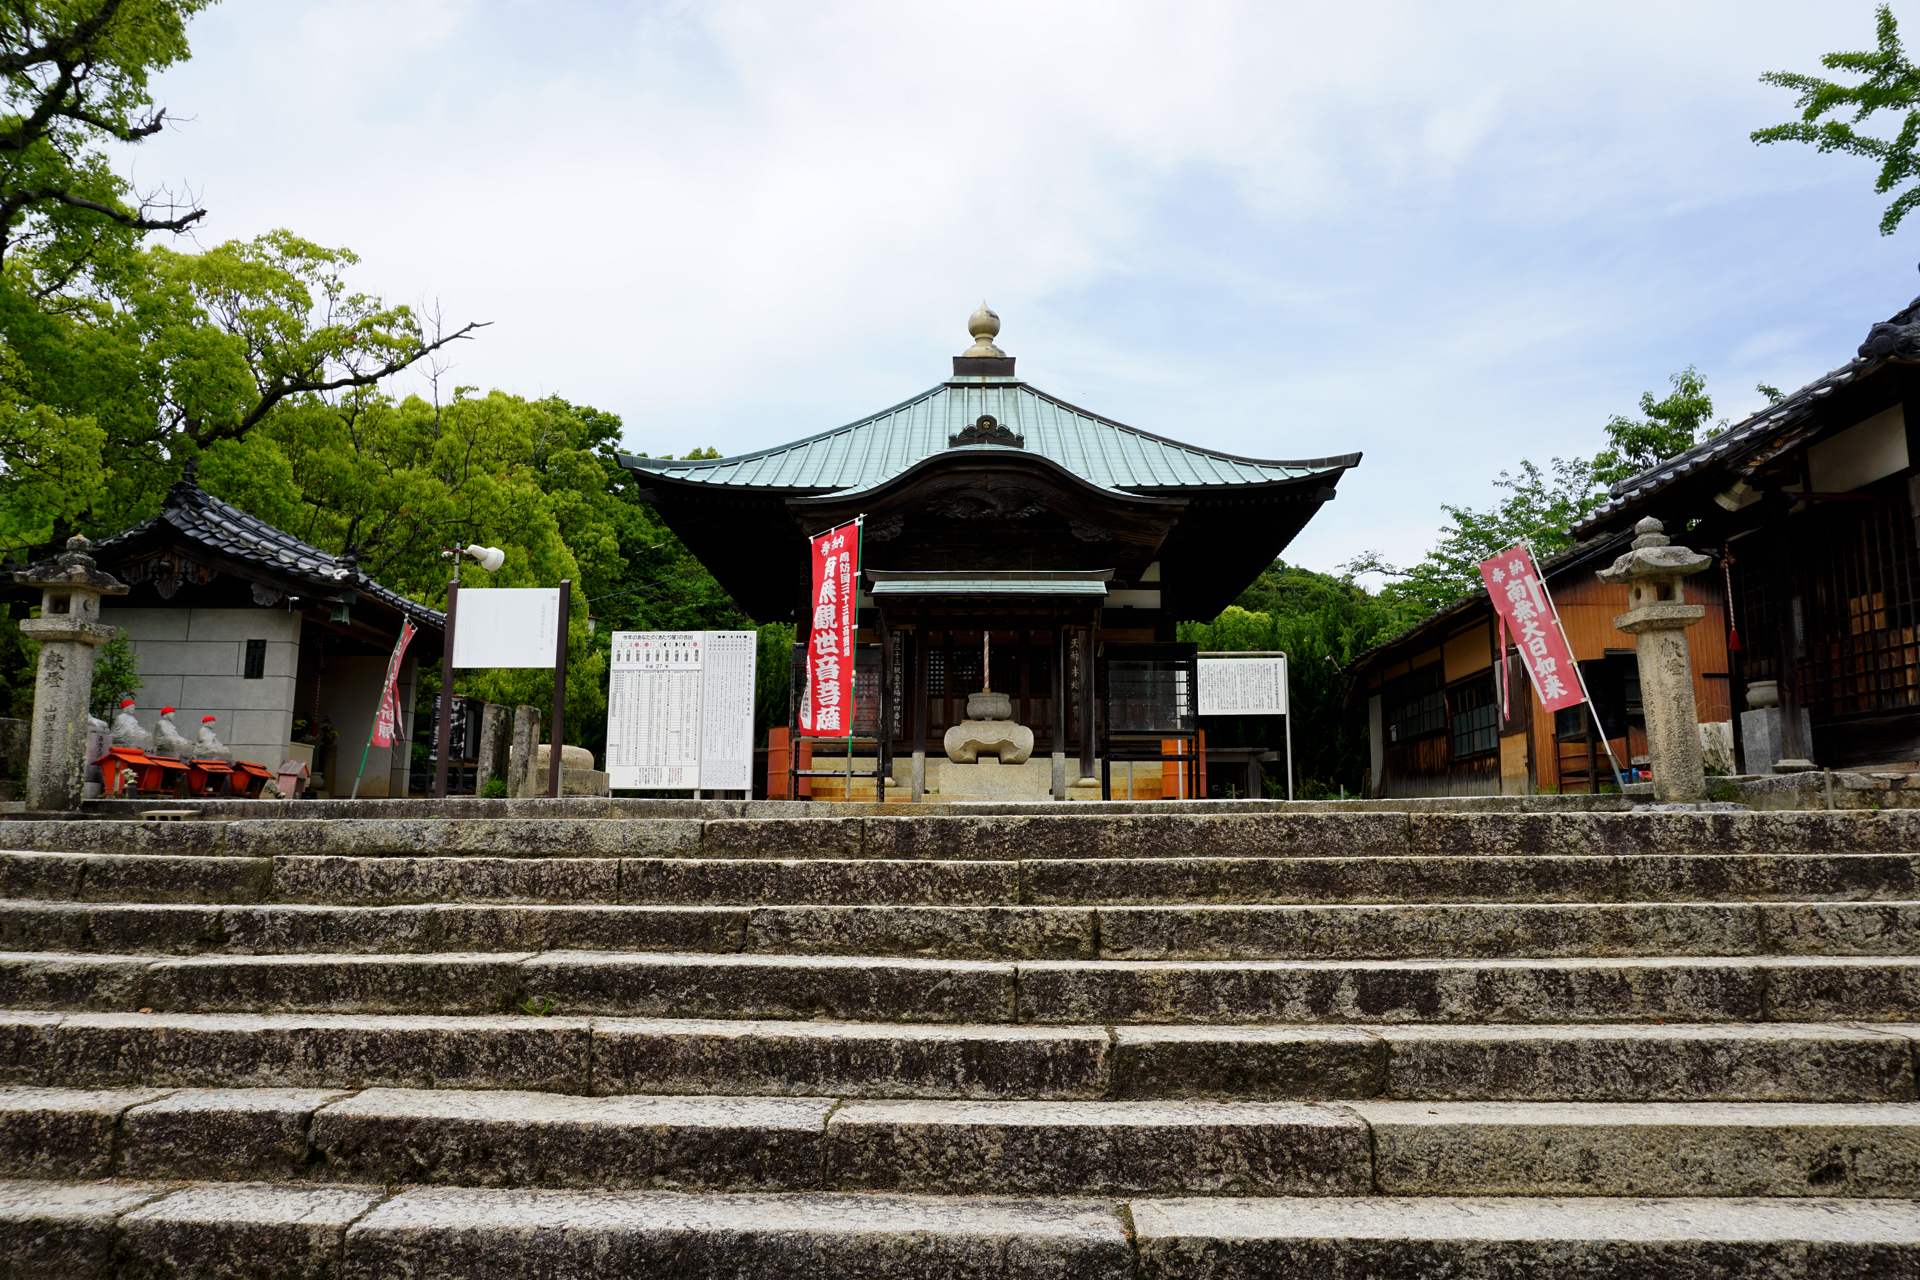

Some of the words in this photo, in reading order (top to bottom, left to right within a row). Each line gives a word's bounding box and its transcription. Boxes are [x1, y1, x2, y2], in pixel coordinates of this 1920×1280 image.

[821, 534, 845, 557] 奉納
[1491, 558, 1526, 584] 奉納
[1504, 579, 1569, 700] 南無大日如来
